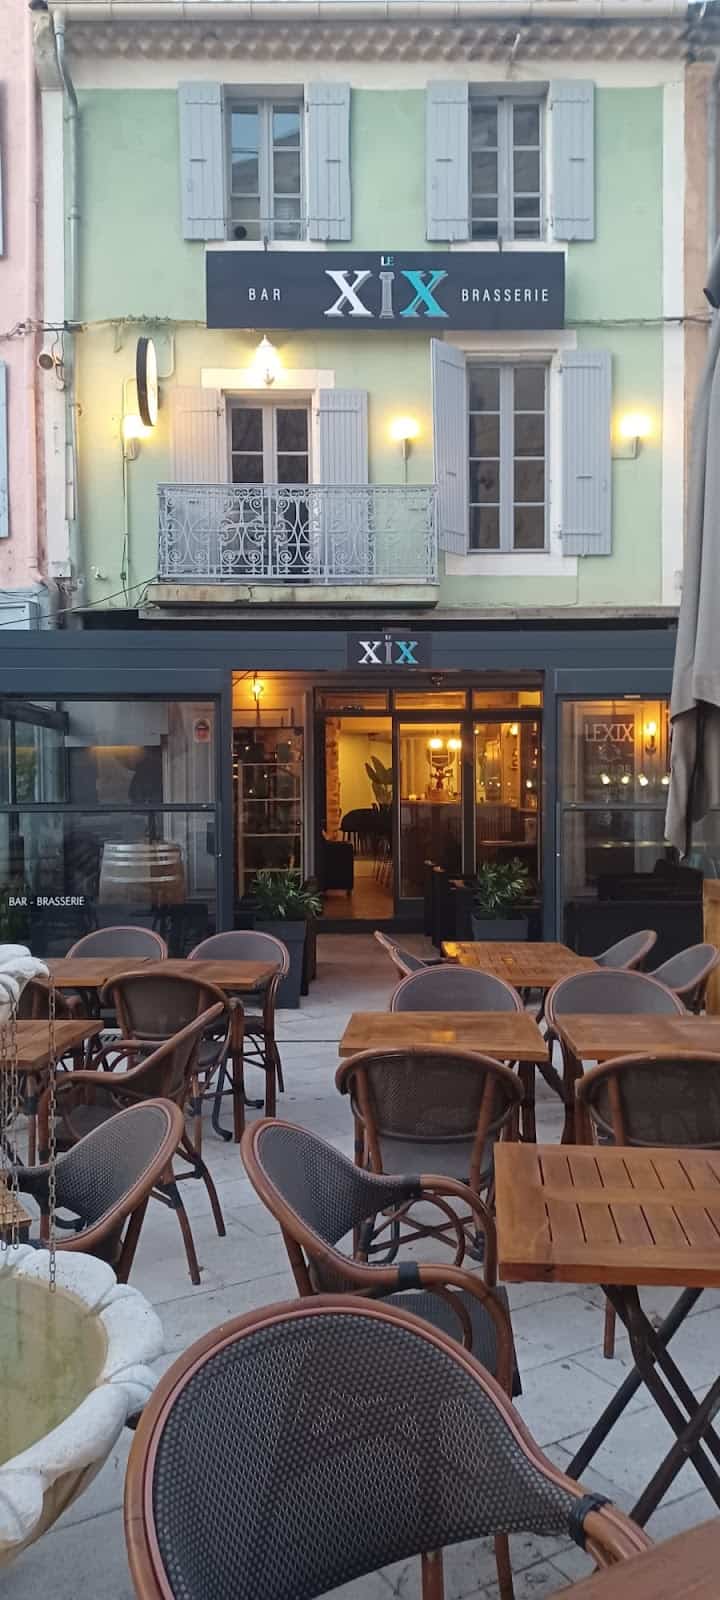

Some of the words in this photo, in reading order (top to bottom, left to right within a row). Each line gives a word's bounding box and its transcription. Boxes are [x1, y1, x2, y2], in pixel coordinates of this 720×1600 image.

[380, 256, 394, 266] LE
[248, 288, 282, 301] BAR
[324, 270, 449, 319] XIX
[461, 288, 550, 302] BRASSERIE
[358, 641, 418, 664] XIX
[8, 896, 28, 907] BAR
[36, 896, 85, 906] BRASSERIE
